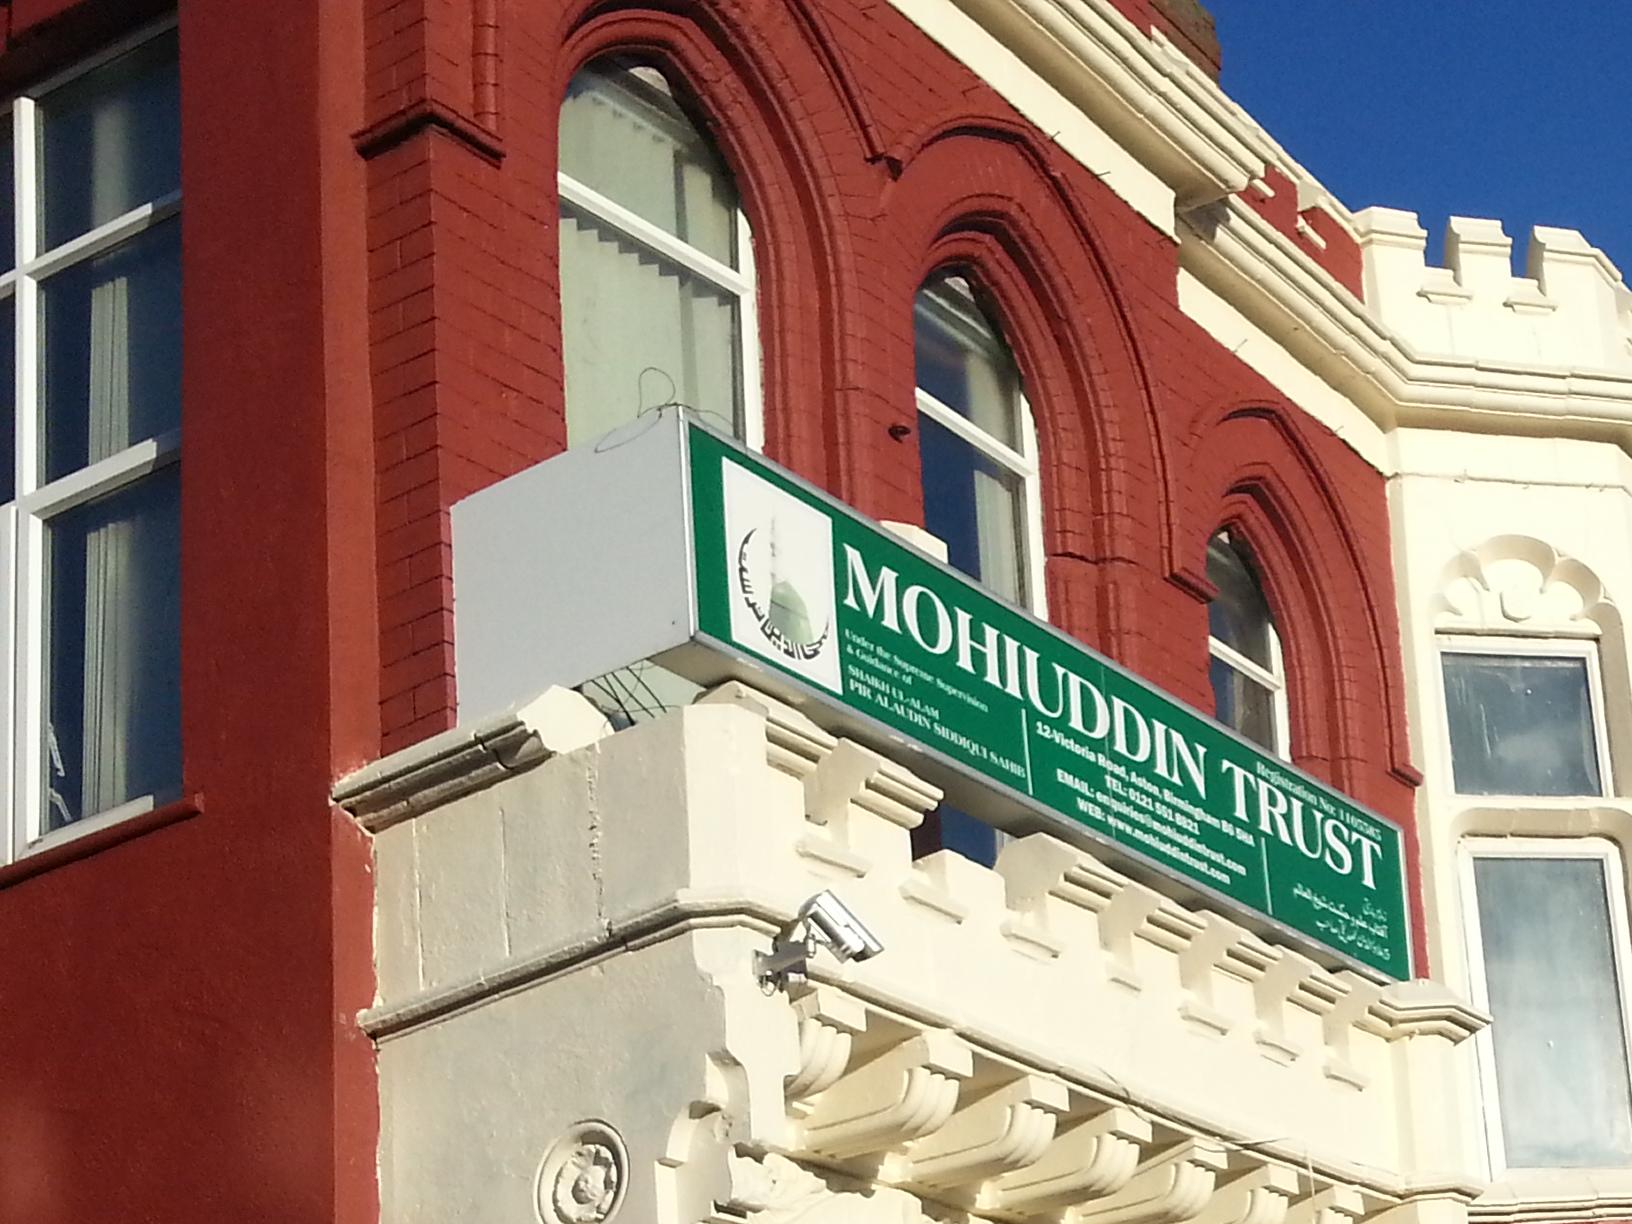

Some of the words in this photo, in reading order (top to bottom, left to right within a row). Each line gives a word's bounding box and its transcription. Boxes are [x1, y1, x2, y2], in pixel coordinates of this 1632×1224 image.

[845, 629, 875, 651] Under
[876, 646, 892, 660] the
[893, 655, 935, 683] Supreme
[936, 678, 989, 713] Supervision
[856, 649, 899, 678] Guidance
[902, 674, 913, 686] of
[843, 543, 1207, 800] MOHIUDDIN
[1222, 760, 1382, 889] TRUST
[849, 679, 872, 700] PIR
[875, 696, 931, 730] ALAUDIN
[933, 722, 988, 760] SIDDIQUI
[989, 750, 1027, 779] SAHIB
[1056, 768, 1095, 798] EMAIL:
[1097, 752, 1129, 782] Road,
[1130, 771, 1163, 800] Aston,
[1163, 788, 1221, 829] Birmingham
[1104, 774, 1128, 797] TEL:
[1128, 787, 1154, 811] 0121
[1256, 761, 1317, 805] Registration
[1076, 797, 1106, 821] WEB:
